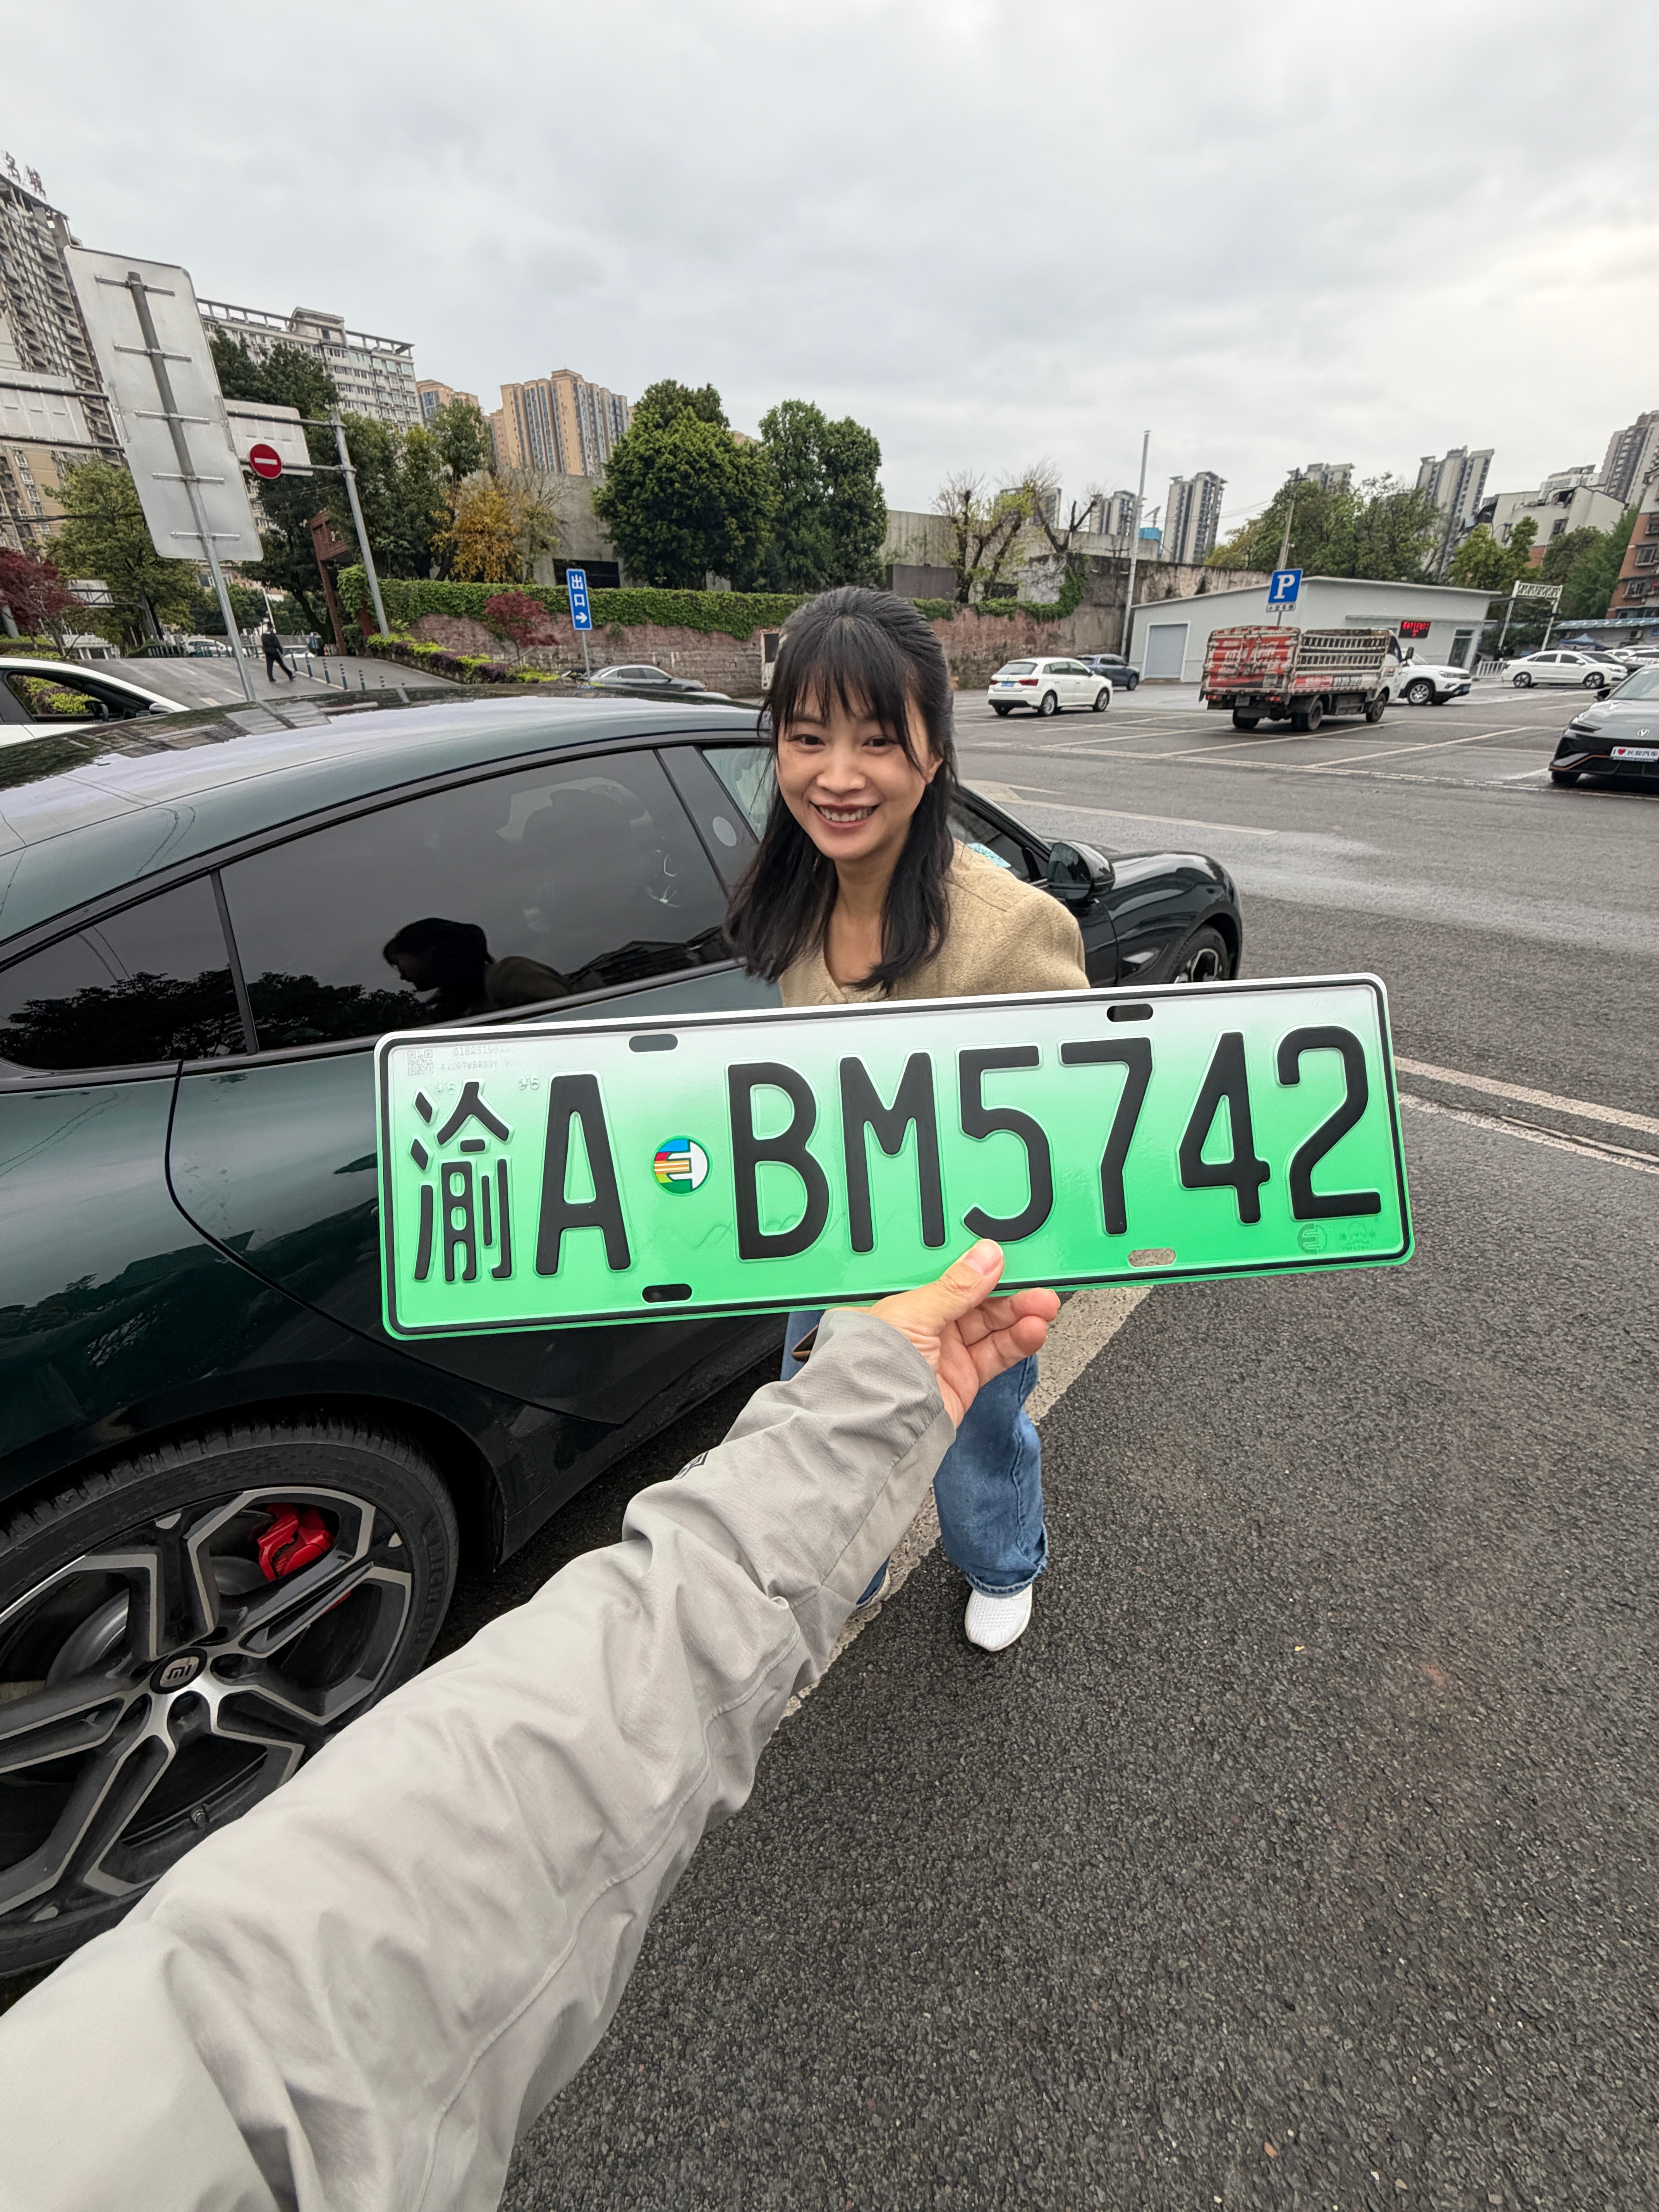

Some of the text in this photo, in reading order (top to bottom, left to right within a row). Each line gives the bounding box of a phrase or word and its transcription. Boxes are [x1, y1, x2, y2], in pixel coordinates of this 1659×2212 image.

[571, 574, 585, 607] 出口
[1273, 574, 1295, 599] P
[728, 1025, 1381, 1260] BM5742
